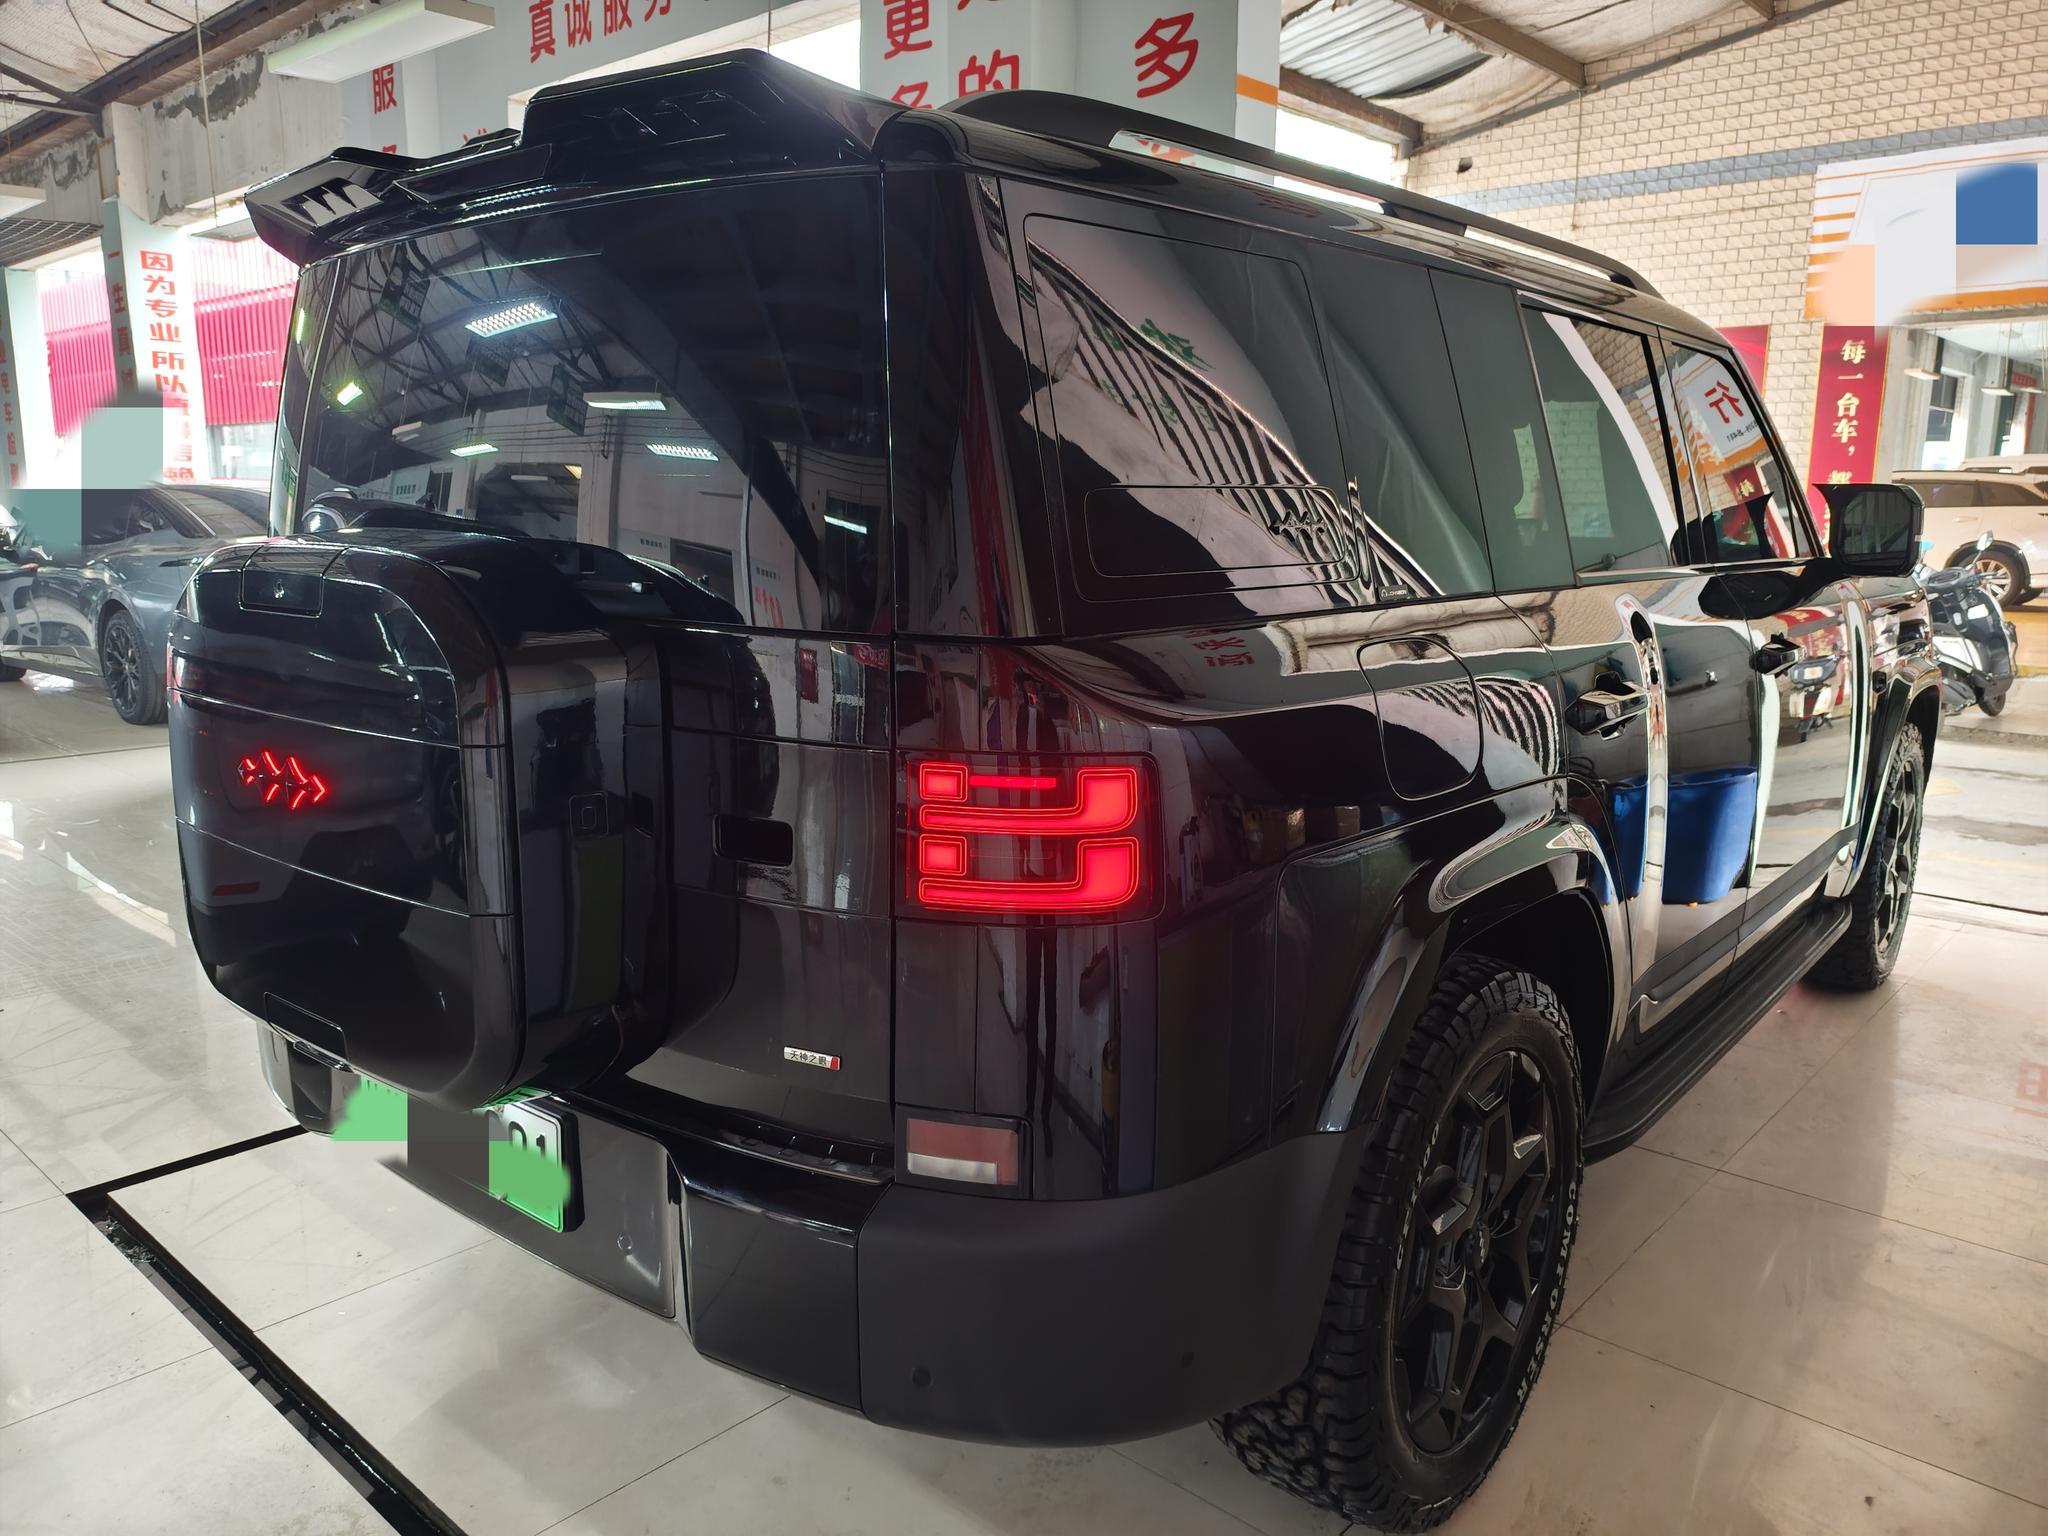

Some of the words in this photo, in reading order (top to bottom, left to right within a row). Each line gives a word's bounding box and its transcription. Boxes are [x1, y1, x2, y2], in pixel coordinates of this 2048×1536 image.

[790, 1050, 827, 1066] 天神之眼
[1516, 1181, 1577, 1403] COMFORSER
